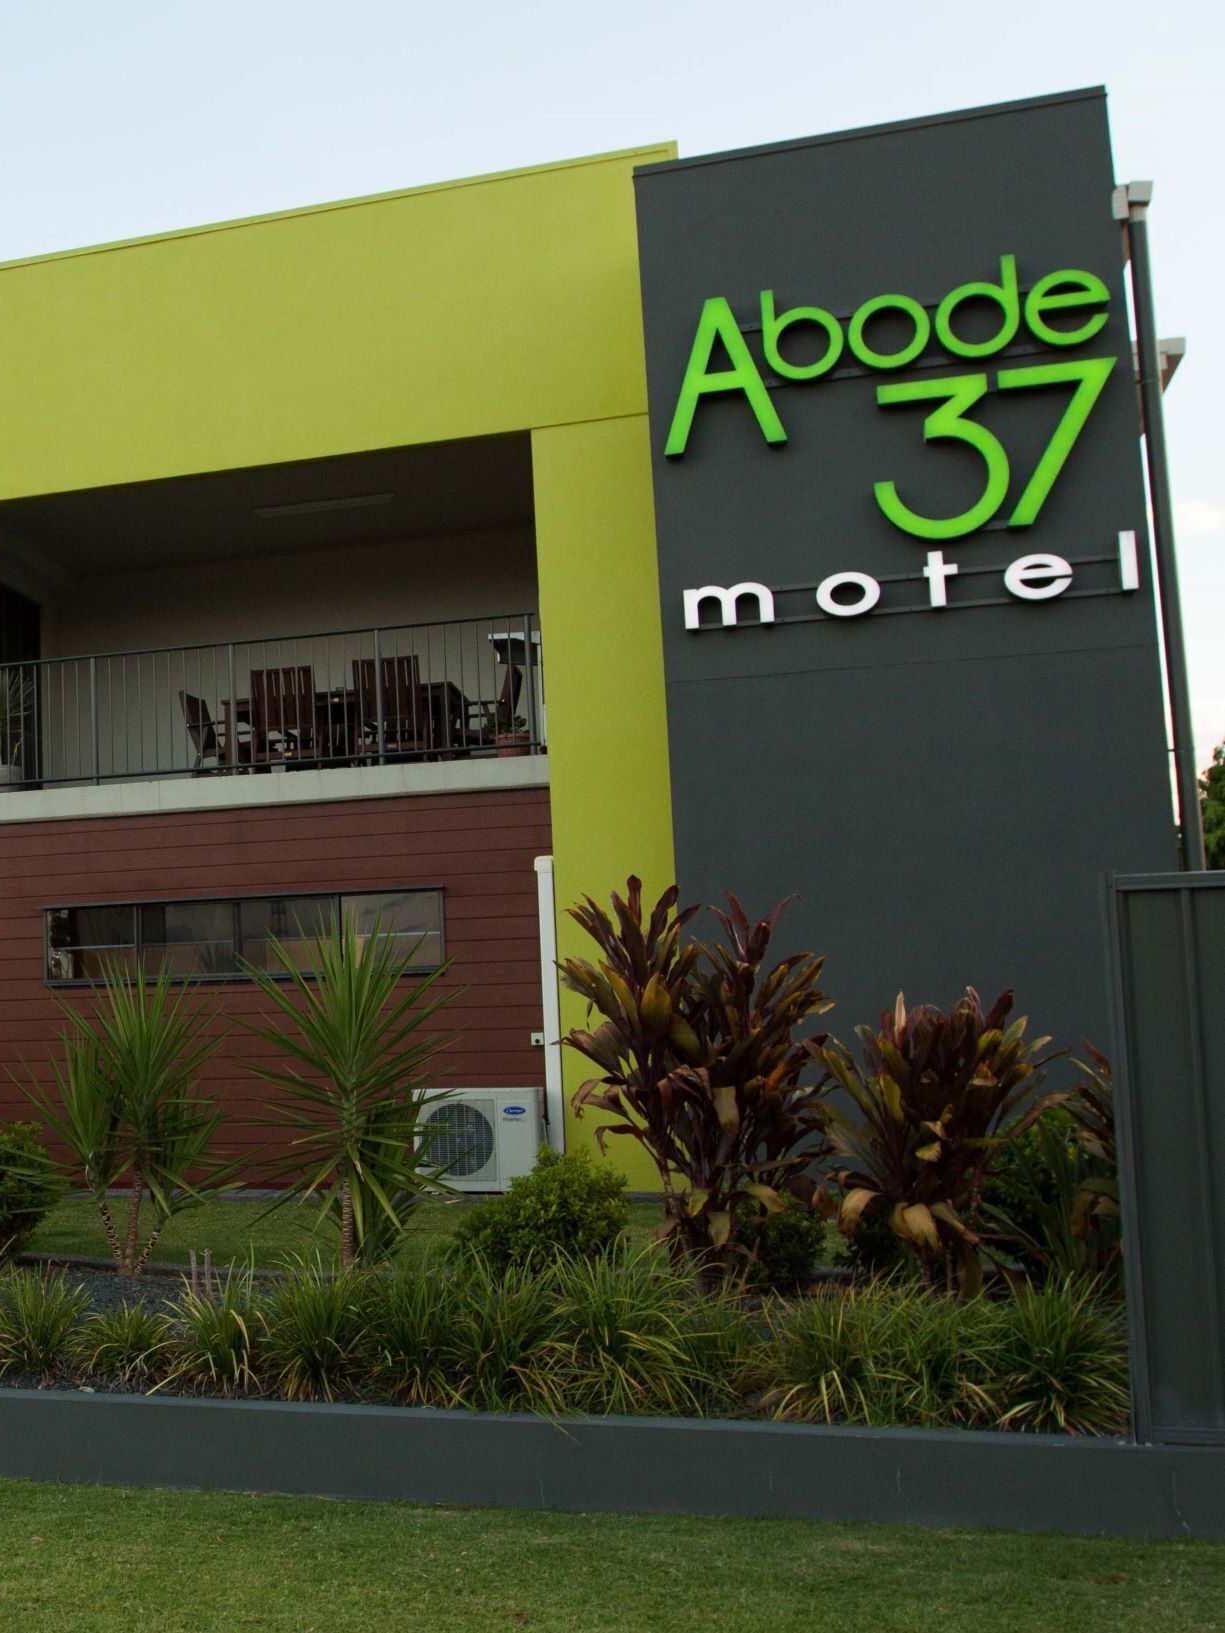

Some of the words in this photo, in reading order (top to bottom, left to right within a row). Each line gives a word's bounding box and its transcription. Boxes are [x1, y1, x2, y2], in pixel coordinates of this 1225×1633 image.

[665, 254, 1111, 459] Abode
[873, 356, 1117, 539] 37
[682, 530, 1139, 631] motel
